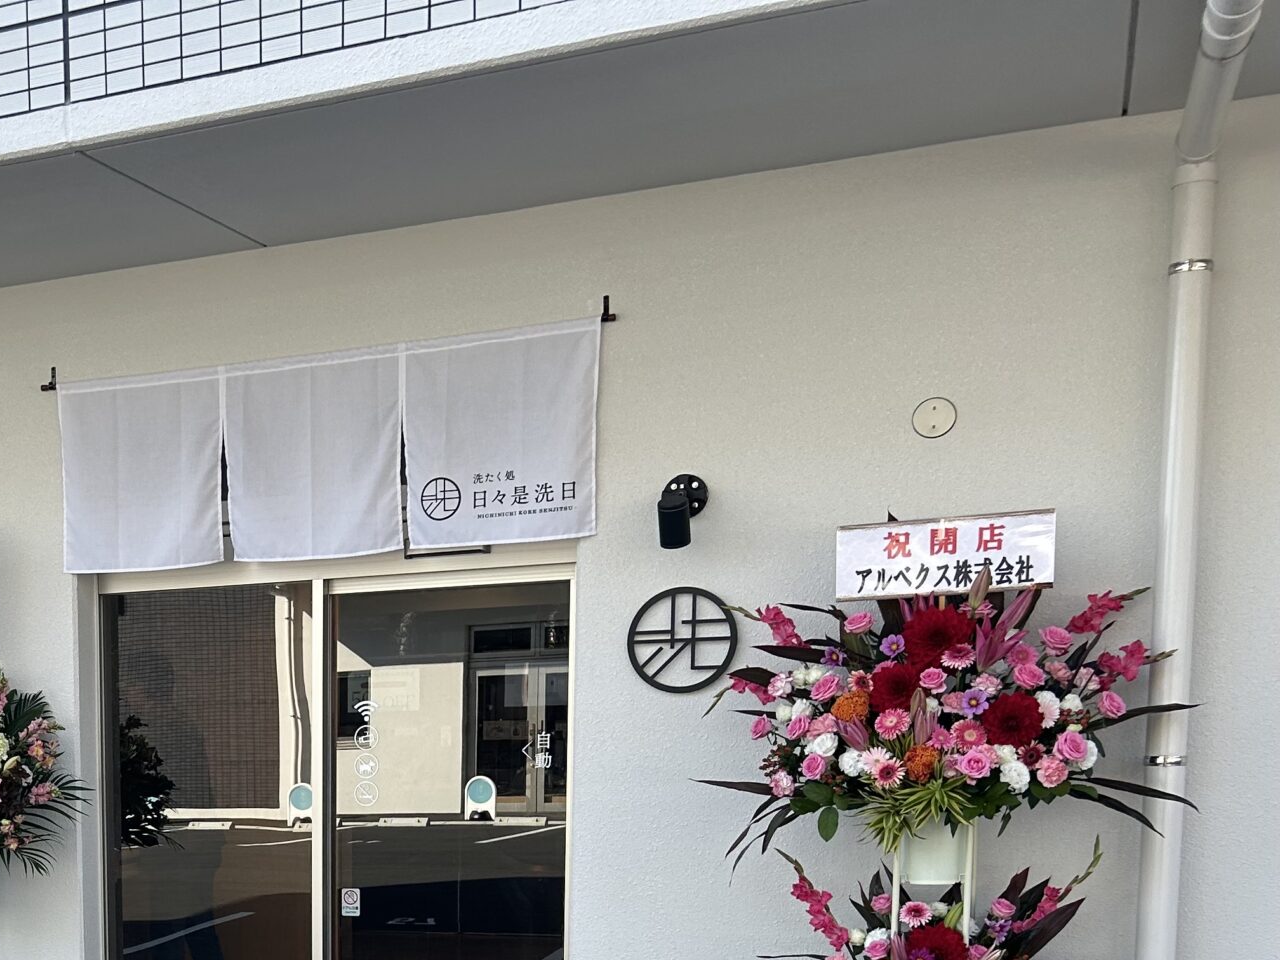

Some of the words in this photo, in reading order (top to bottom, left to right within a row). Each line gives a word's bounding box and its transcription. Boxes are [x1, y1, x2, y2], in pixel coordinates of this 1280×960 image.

[472, 470, 515, 484] 洗たく処
[473, 481, 577, 510] 日々是洗日
[477, 511, 517, 520] NICHINICHI
[538, 506, 573, 514] SENJITSU
[883, 523, 1006, 560] 祝開店
[535, 731, 552, 769] 自動
